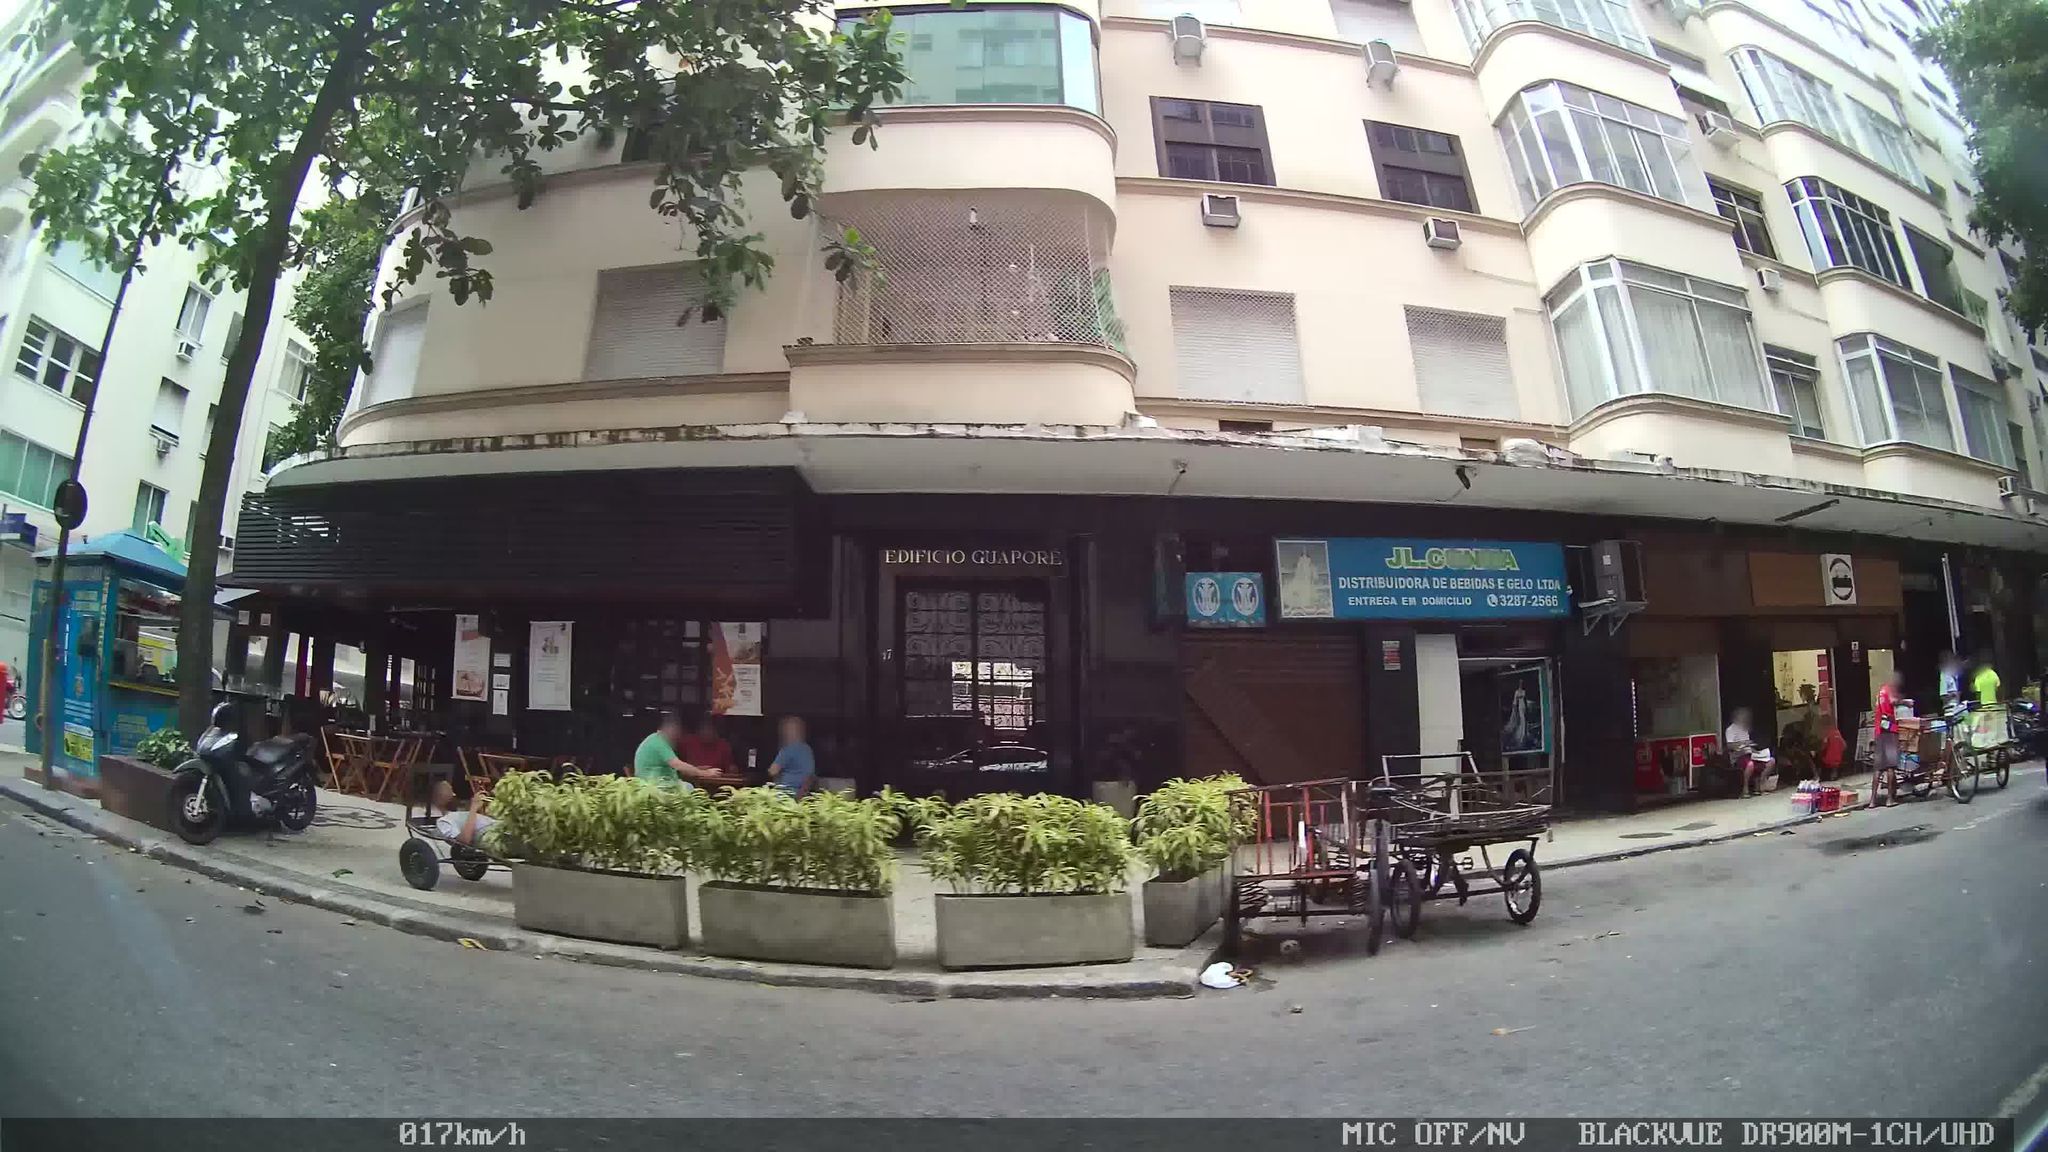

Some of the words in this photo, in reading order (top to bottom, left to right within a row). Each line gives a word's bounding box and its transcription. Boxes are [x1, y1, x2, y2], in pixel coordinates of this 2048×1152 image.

[884, 549, 966, 565] EDIFICIO
[971, 550, 1063, 566] GUAPORE
[1338, 576, 1431, 590] DISTRIBUIDORA
[1432, 577, 1448, 590] DE
[1449, 577, 1495, 590] BEBIDAS
[1497, 579, 1505, 590] E
[1506, 578, 1534, 590] GELO
[1537, 578, 1561, 591] LTDA
[1347, 596, 1398, 606] ENTREGA
[1422, 596, 1472, 606] DOMICILIO
[1499, 594, 1559, 607] 3287-2566
